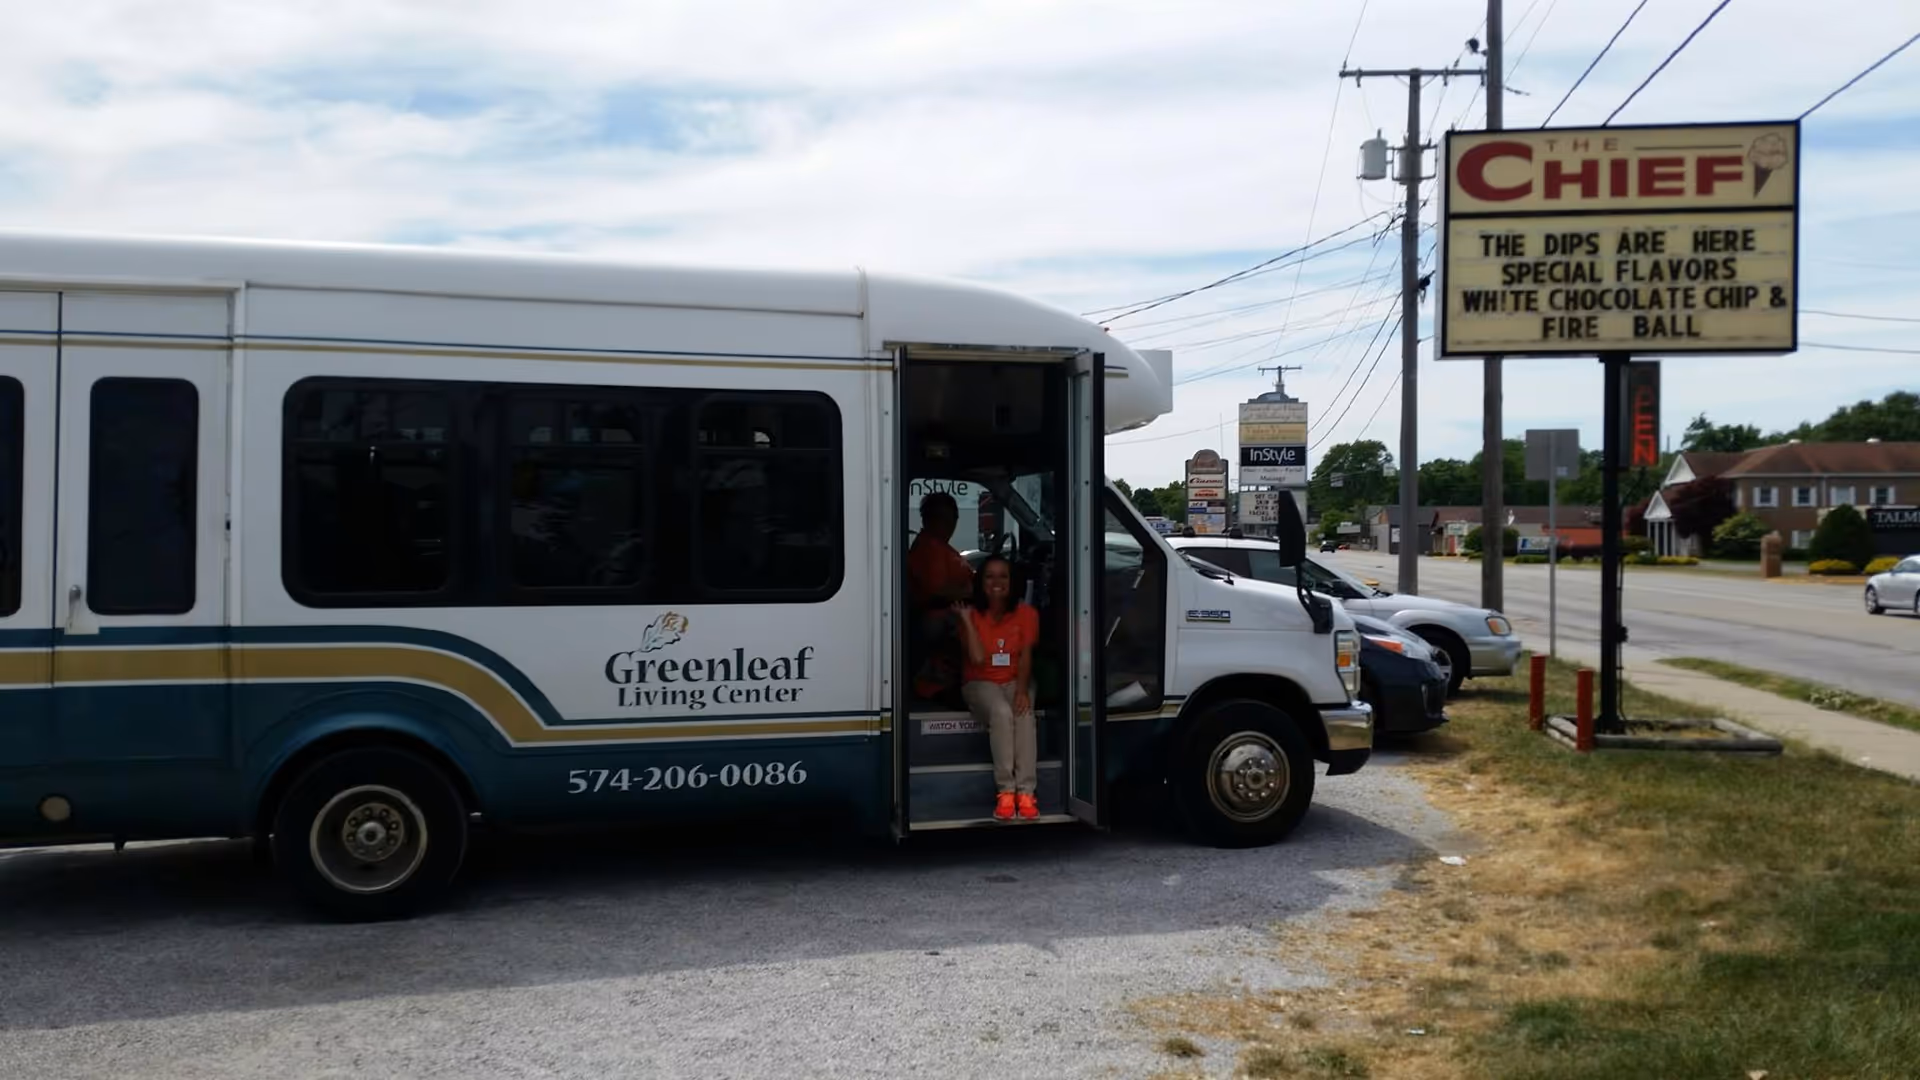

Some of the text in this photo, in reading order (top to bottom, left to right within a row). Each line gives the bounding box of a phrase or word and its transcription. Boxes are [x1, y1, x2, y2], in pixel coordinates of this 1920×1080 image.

[1545, 138, 1619, 152] THE
[1456, 140, 1743, 202] CHIEF
[1480, 229, 1755, 257] THE DIPS ARE HERE
[1502, 257, 1737, 286] SPECIAL FLAVORS
[1549, 287, 1695, 311] CHOCOLATE
[1705, 286, 1759, 310] CHIP
[1769, 286, 1786, 307] &
[1543, 314, 1700, 339] FIRE BALL
[1632, 366, 1657, 466] PEN
[1250, 447, 1296, 465] InStyle
[1874, 511, 1920, 523] TALM
[605, 646, 814, 684] Greenleaf
[618, 684, 803, 710] Living Center
[567, 760, 807, 793] 574-206-0086
